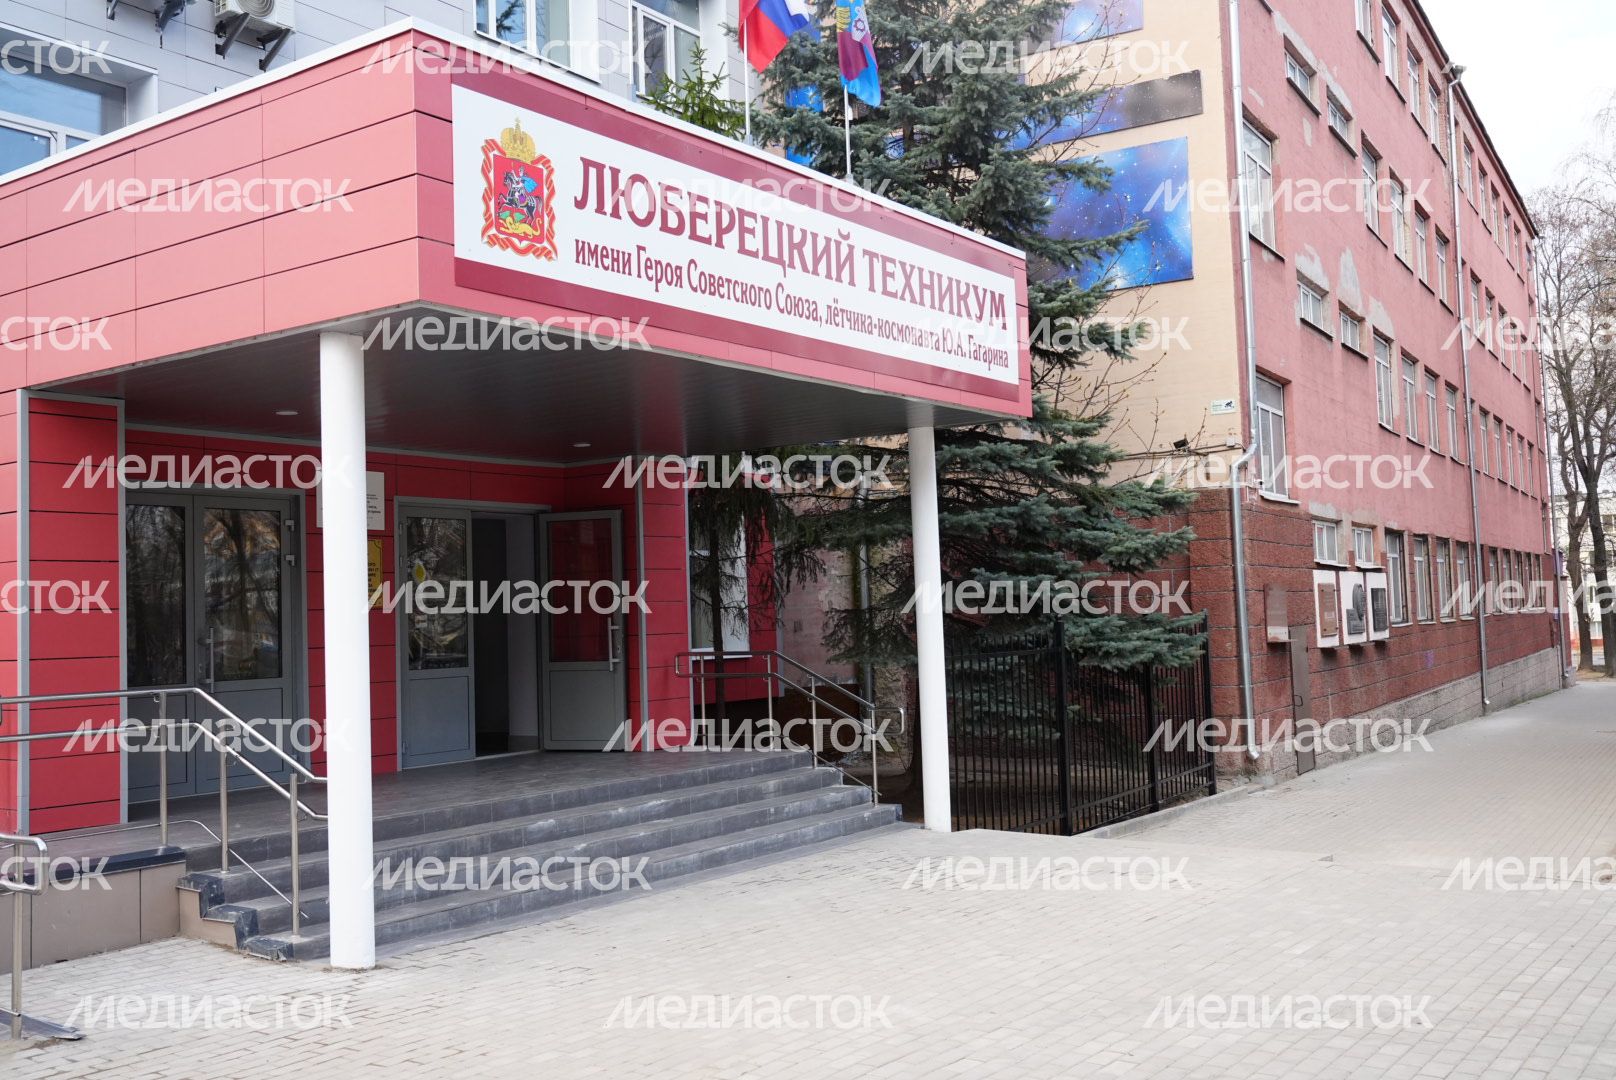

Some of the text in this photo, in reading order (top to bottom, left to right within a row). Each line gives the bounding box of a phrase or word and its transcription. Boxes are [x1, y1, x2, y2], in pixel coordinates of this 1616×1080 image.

[574, 157, 1007, 331] ЛЮБЕРЕЦКИЙ ТЕХНИКУМ
[575, 239, 632, 276] имени
[636, 244, 683, 292] Героя
[687, 258, 772, 310] Советского
[776, 282, 823, 328] Союза,
[825, 298, 940, 351] лётчика-космонавта
[968, 334, 1009, 371] Гагарина
